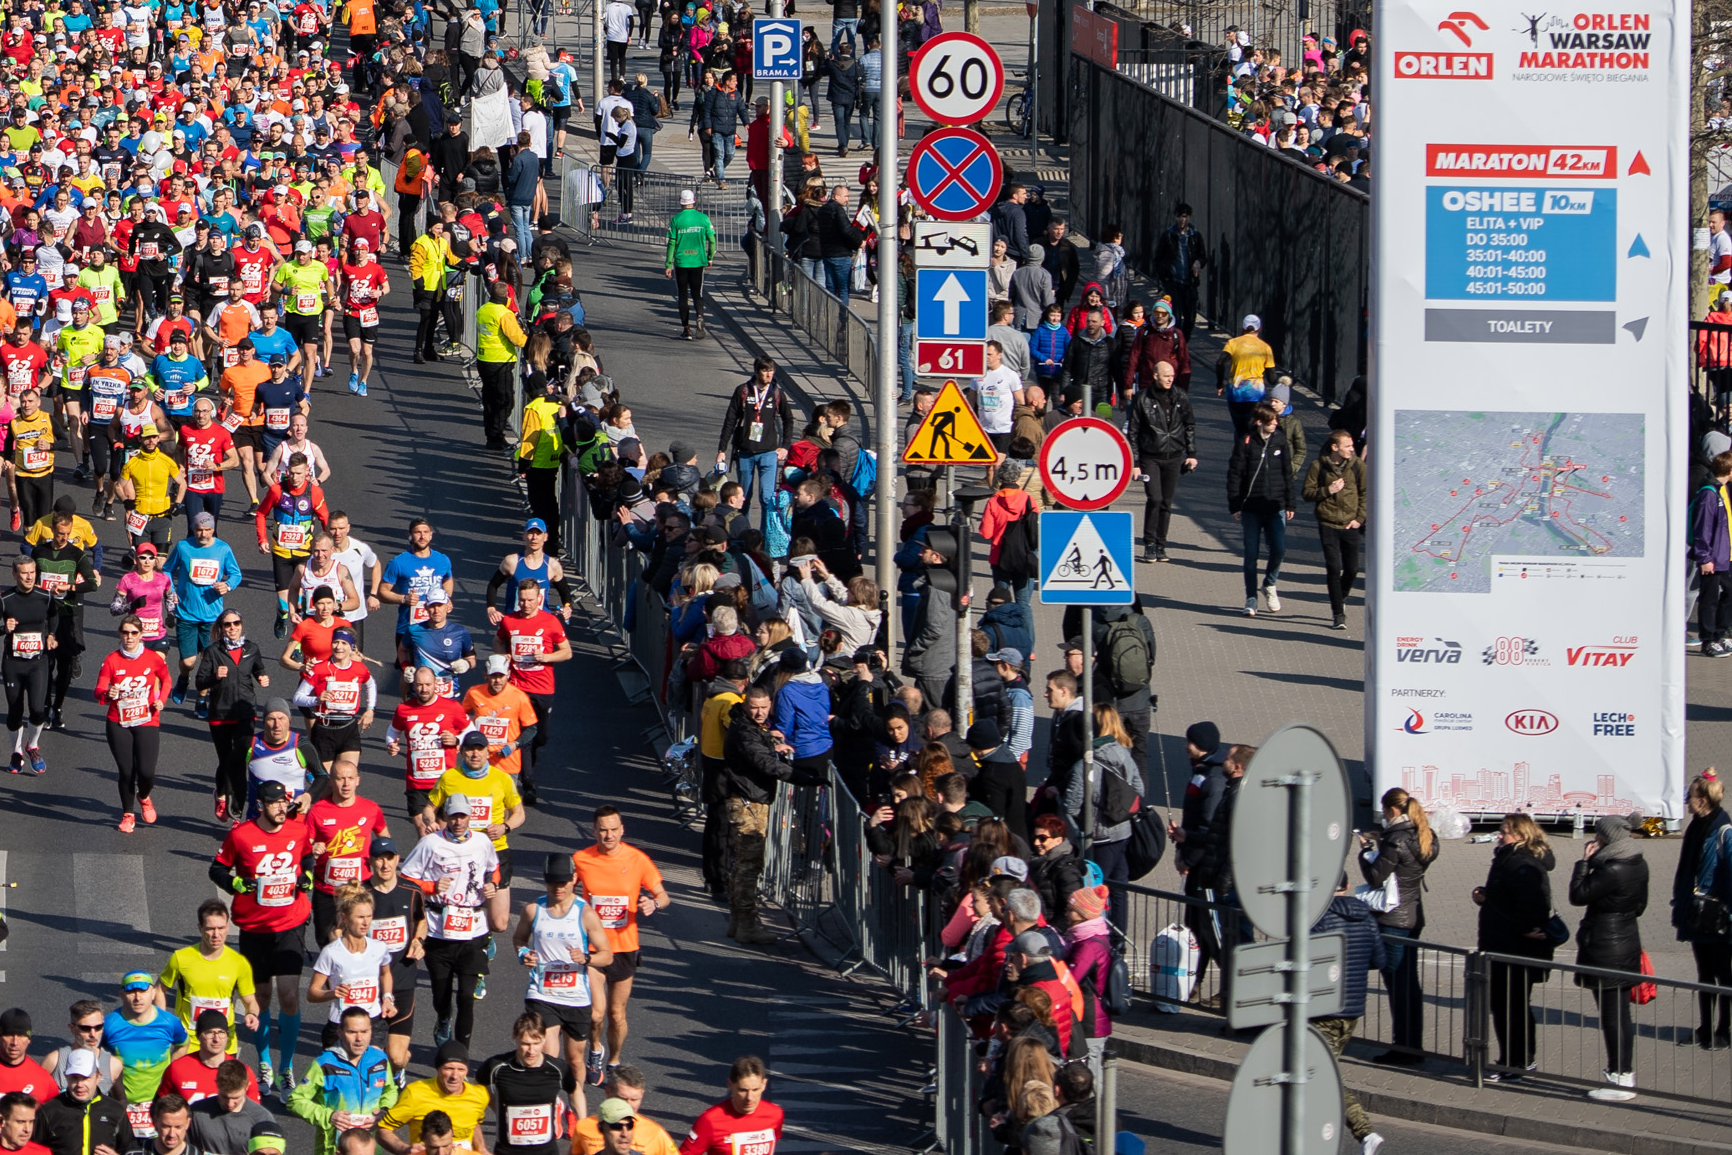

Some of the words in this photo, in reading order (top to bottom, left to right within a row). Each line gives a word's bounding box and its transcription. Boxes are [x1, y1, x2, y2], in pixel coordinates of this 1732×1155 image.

[1573, 13, 1650, 31] ORLEN
[1550, 33, 1652, 50] WARSAW
[763, 36, 789, 67] P
[1398, 55, 1488, 77] ORLEN
[1518, 52, 1649, 69] MARATHON
[756, 69, 789, 77] BRAMA
[791, 69, 798, 77] 4
[927, 54, 989, 100] 60
[1512, 72, 1568, 82] NARODOWE
[1607, 73, 1649, 83] BIEGANIA
[1435, 152, 1546, 172] MARATON
[1552, 153, 1601, 171] 42KM
[1442, 191, 1536, 212] OSHEE
[1548, 194, 1587, 212] 10KM
[1466, 217, 1504, 230] ELITA
[1520, 218, 1544, 230] VIP
[1466, 234, 1487, 246] DO
[1490, 234, 1528, 246] 35:00
[1466, 250, 1546, 263] 35:01-40:00
[1466, 266, 1546, 279] 40:01-45:00
[1466, 282, 1546, 295] 45:01-50:00
[1488, 320, 1553, 334] TOALETY
[940, 348, 965, 370] 61
[28, 452, 47, 462] 5214
[1094, 460, 1118, 481] m
[282, 531, 302, 541] 2928
[194, 565, 215, 576] 1673
[408, 575, 442, 587] JESUS
[19, 640, 39, 651] 6002
[1613, 636, 1638, 644] CLUB
[1396, 648, 1462, 664] verva
[1495, 636, 1525, 666] 88
[334, 690, 354, 701] 6214
[1391, 688, 1447, 698] PARTNERZY:
[125, 707, 144, 719] 2287
[1593, 712, 1627, 723] LECH
[1516, 715, 1549, 730] KIA
[483, 725, 503, 736] 1429
[1593, 724, 1635, 736] FREE
[417, 758, 440, 769] 5283
[332, 867, 357, 879] 5403
[267, 883, 290, 896] 4037
[598, 905, 623, 918] 4955
[376, 928, 401, 941] 6372
[349, 987, 373, 1001] 5941
[516, 1117, 544, 1131] 6051
